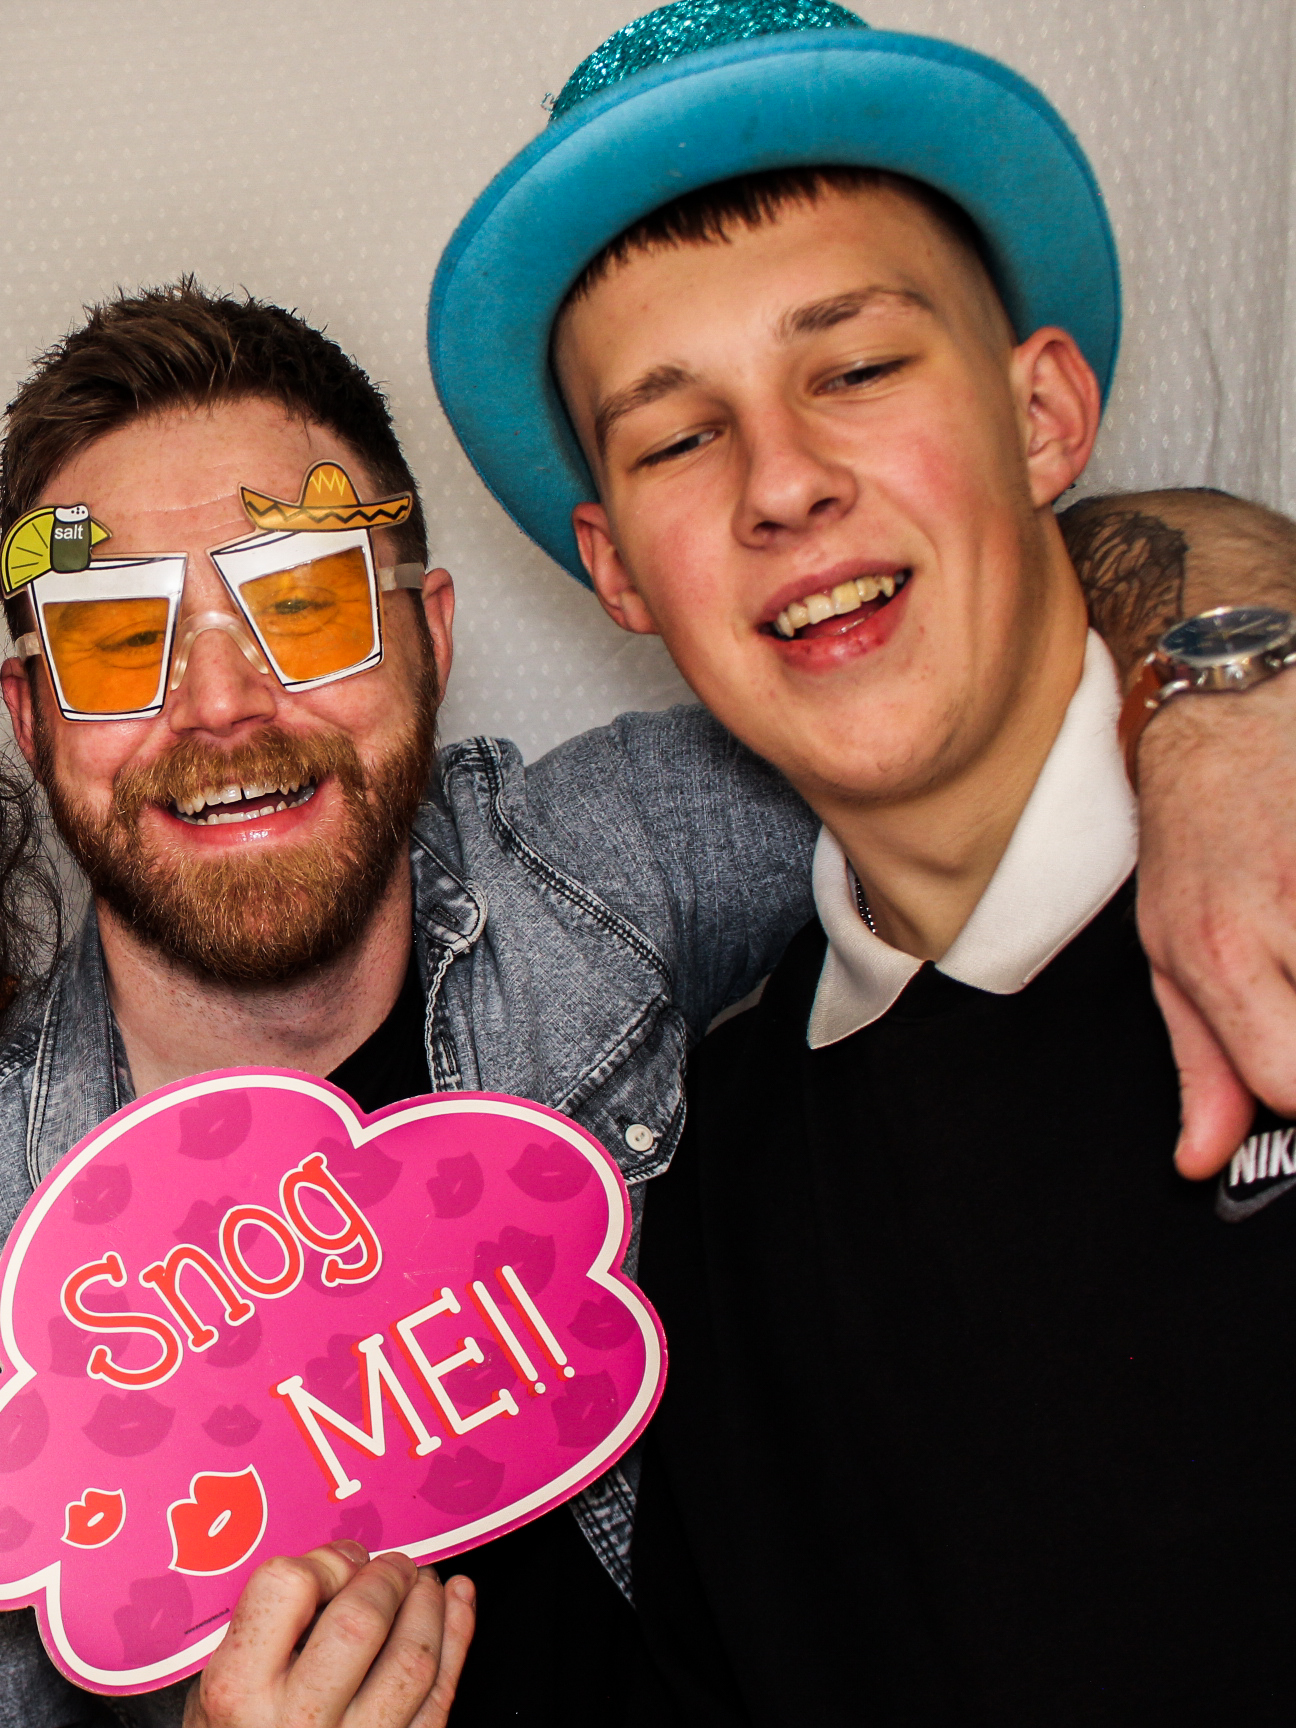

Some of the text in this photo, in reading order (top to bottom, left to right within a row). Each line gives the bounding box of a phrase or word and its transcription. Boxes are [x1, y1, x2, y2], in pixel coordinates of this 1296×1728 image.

[54, 524, 84, 540] salt
[1229, 1126, 1296, 1187] NIK
[60, 1151, 383, 1391] Snog
[269, 1264, 576, 1503] ME!!
